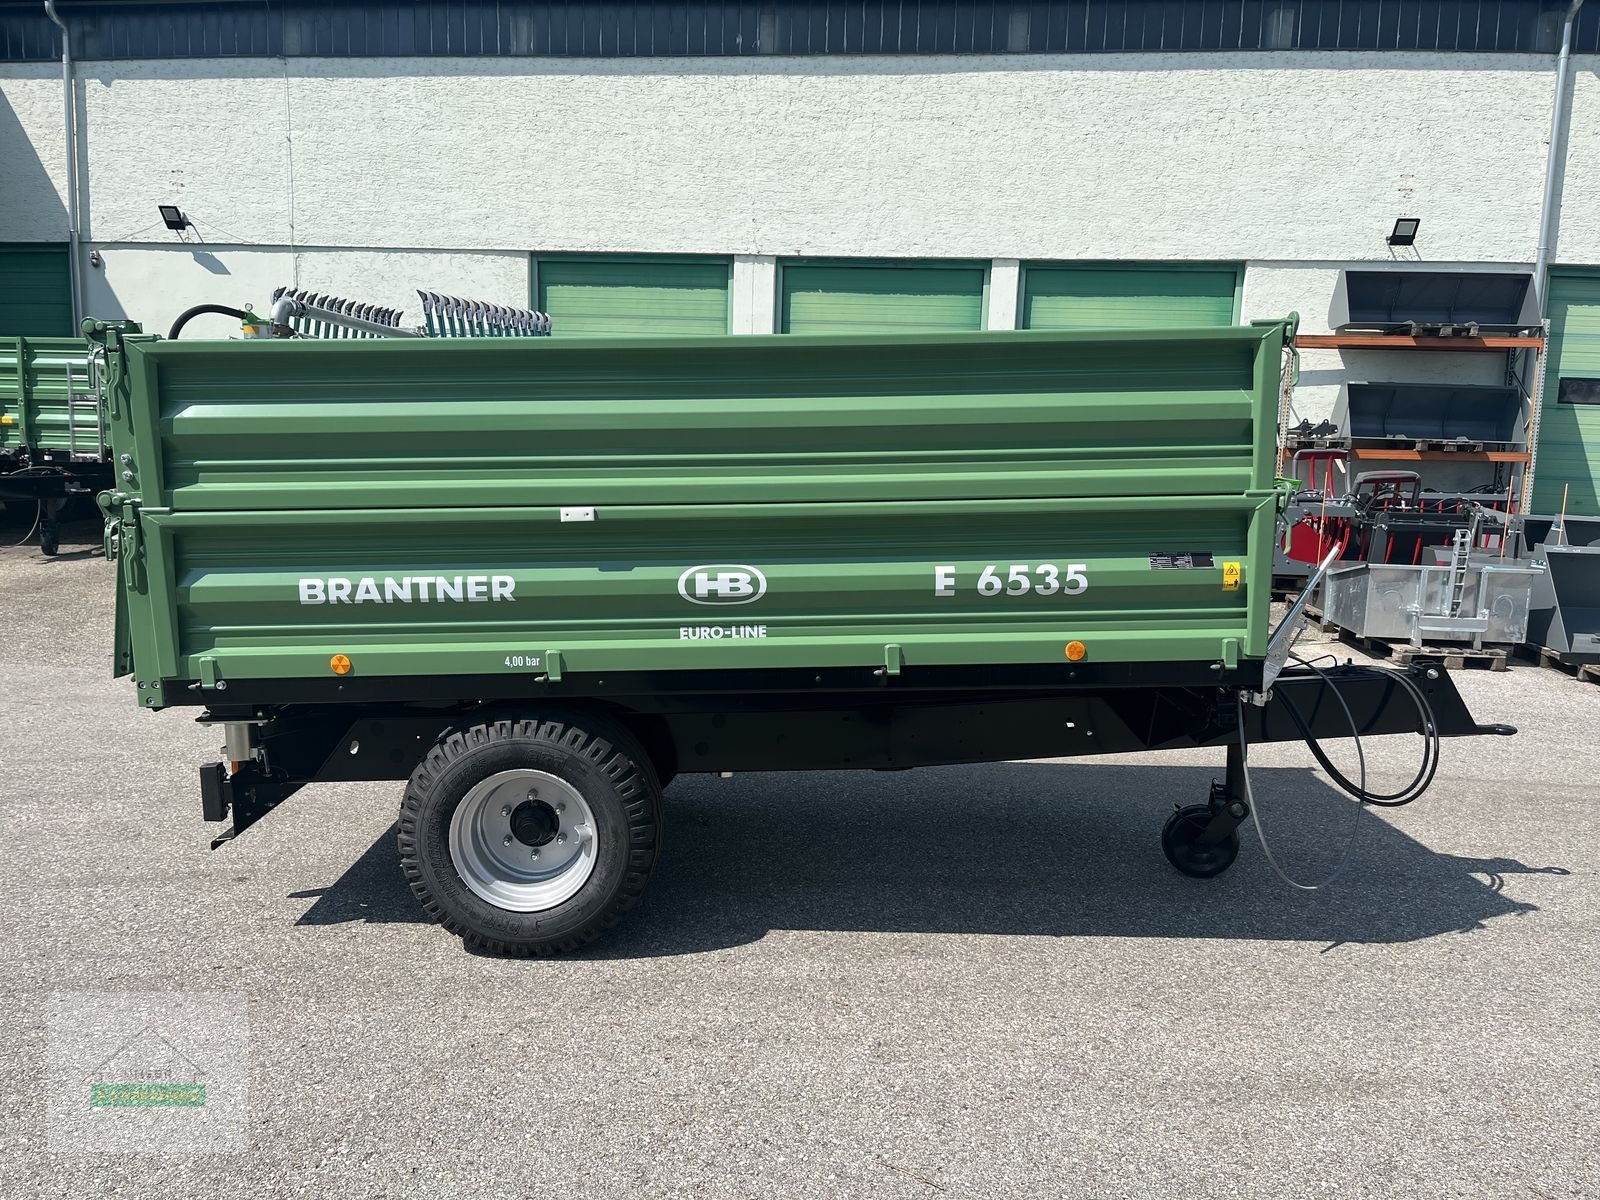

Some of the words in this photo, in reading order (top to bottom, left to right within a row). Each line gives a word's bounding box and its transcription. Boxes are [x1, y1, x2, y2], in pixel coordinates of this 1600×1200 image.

[299, 575, 516, 605] BRANTNER
[695, 572, 753, 597] HB
[935, 565, 955, 597] E
[977, 564, 1088, 596] 6535
[679, 624, 767, 640] EURO-LINE
[504, 656, 524, 668] 4,00
[526, 655, 540, 667] bar
